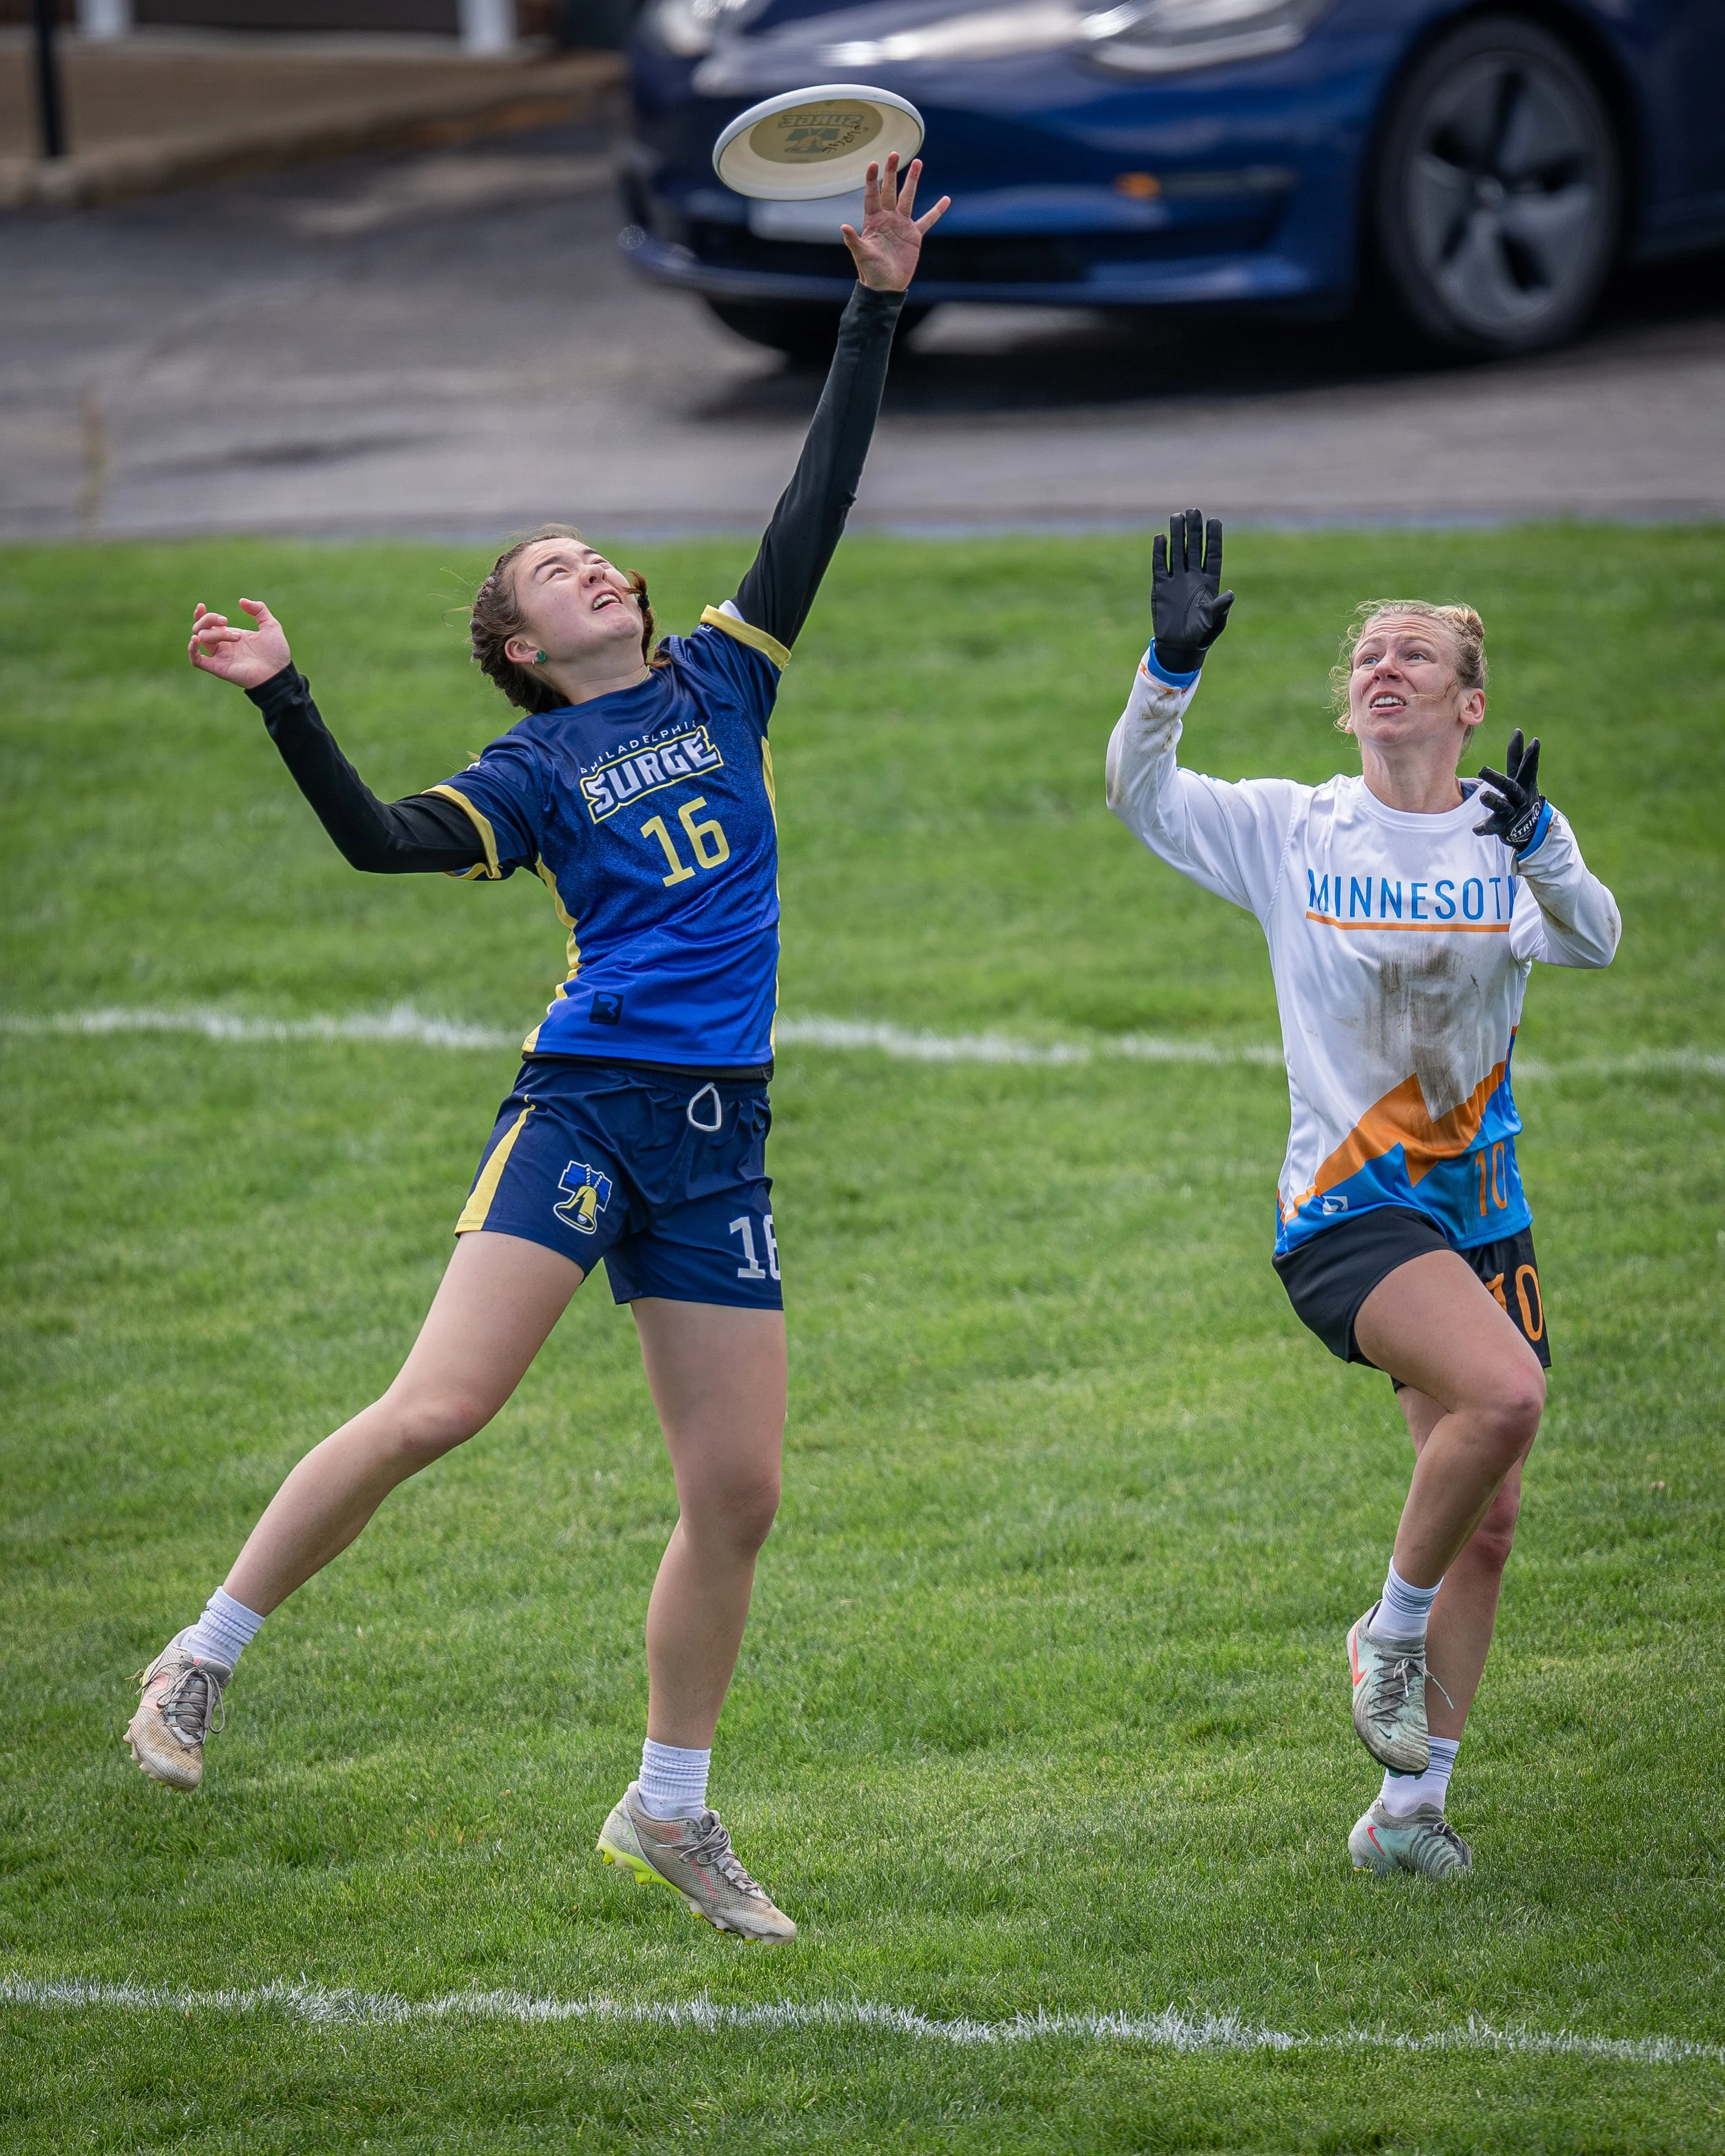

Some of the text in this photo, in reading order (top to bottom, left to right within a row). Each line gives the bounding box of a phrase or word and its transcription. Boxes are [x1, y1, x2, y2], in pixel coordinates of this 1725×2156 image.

[585, 730, 718, 814] SURGE
[640, 796, 730, 887] 16
[1475, 1141, 1508, 1217] 10
